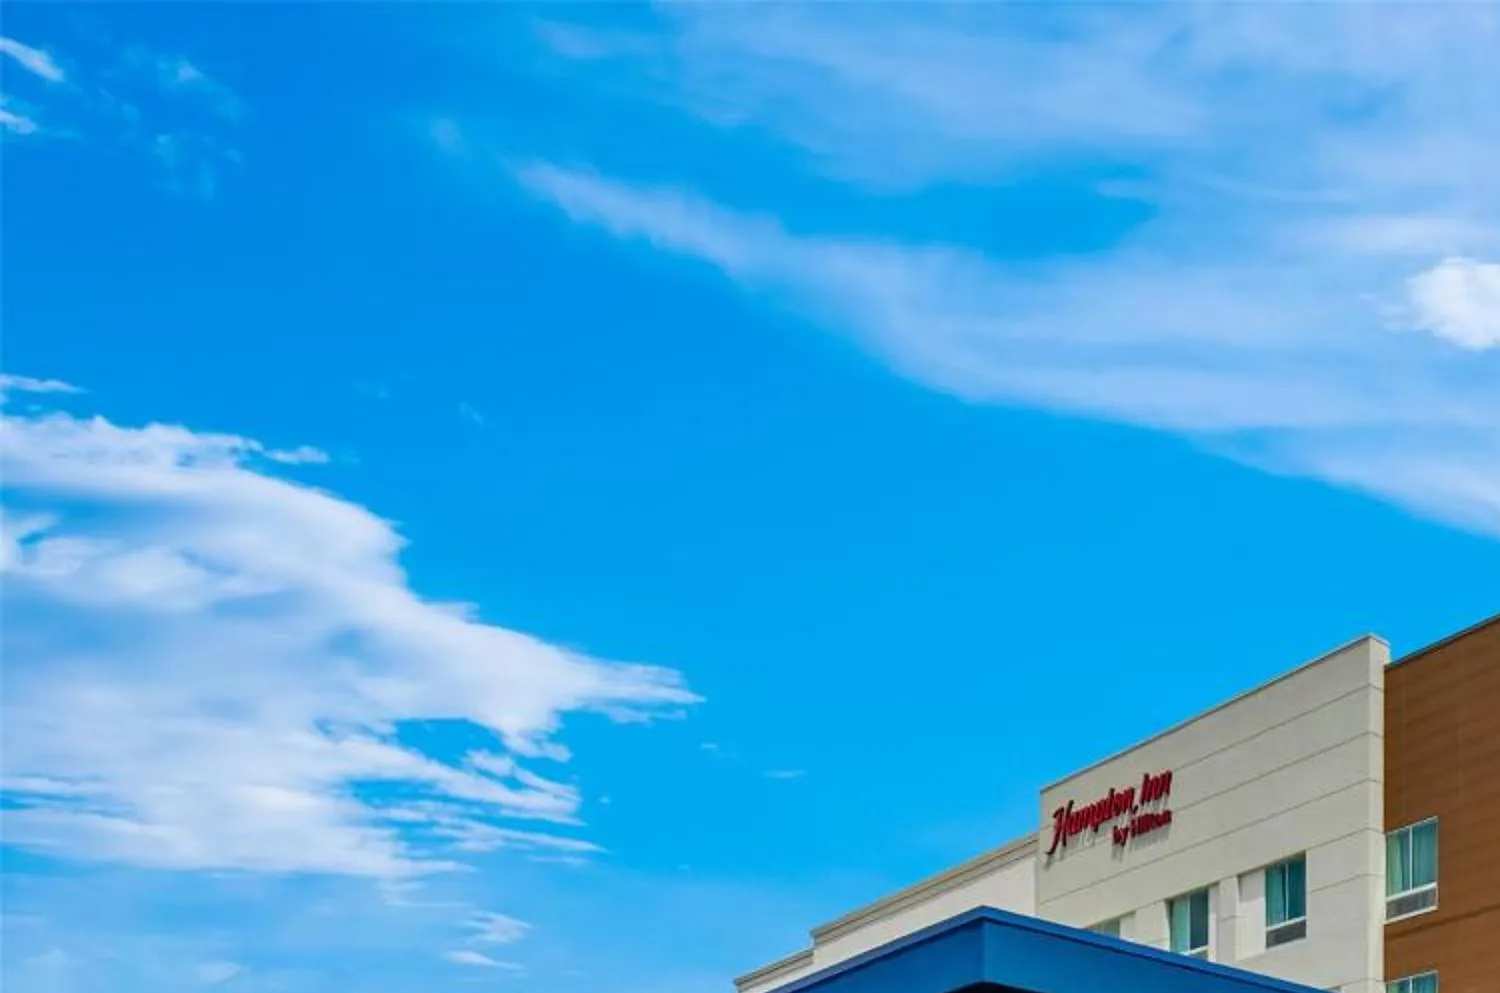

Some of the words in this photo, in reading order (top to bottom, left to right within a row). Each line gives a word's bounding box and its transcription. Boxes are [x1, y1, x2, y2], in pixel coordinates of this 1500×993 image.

[1047, 787, 1135, 854] Hampton
[1133, 769, 1173, 814] Inn
[1113, 825, 1130, 847] by
